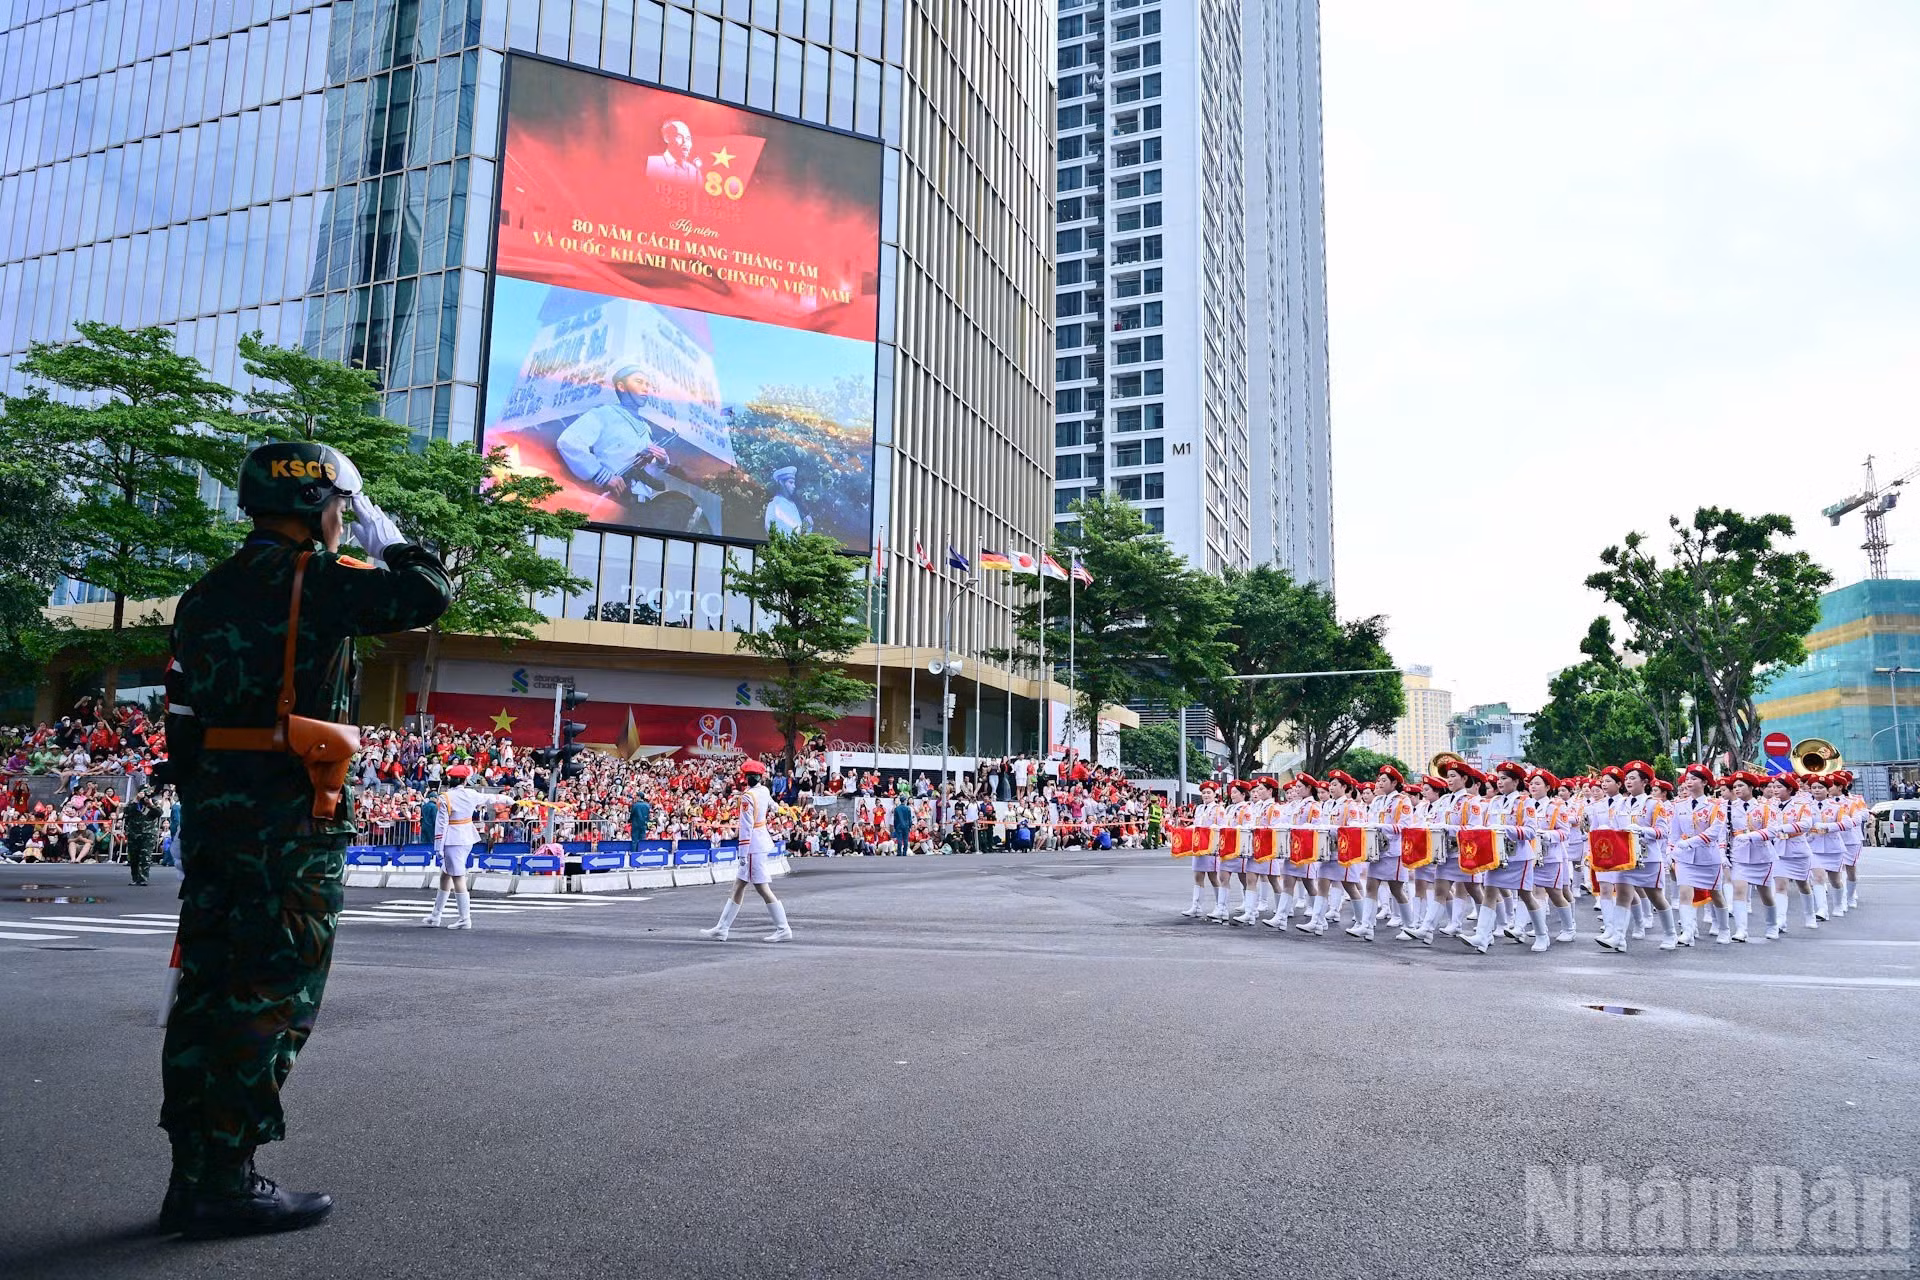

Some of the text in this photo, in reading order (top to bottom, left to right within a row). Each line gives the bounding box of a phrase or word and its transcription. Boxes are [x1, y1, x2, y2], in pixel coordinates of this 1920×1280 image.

[704, 171, 744, 200] 80
[572, 218, 819, 279] 80 NĂM CÁCH MẠNG THÁNG TÁM
[533, 230, 851, 304] VÀ QUỐC KHÁNH NƯỚC CHXHCN VIỆT NAM
[1172, 442, 1191, 456] M1
[621, 584, 724, 617] TOTO
[533, 674, 574, 684] standard
